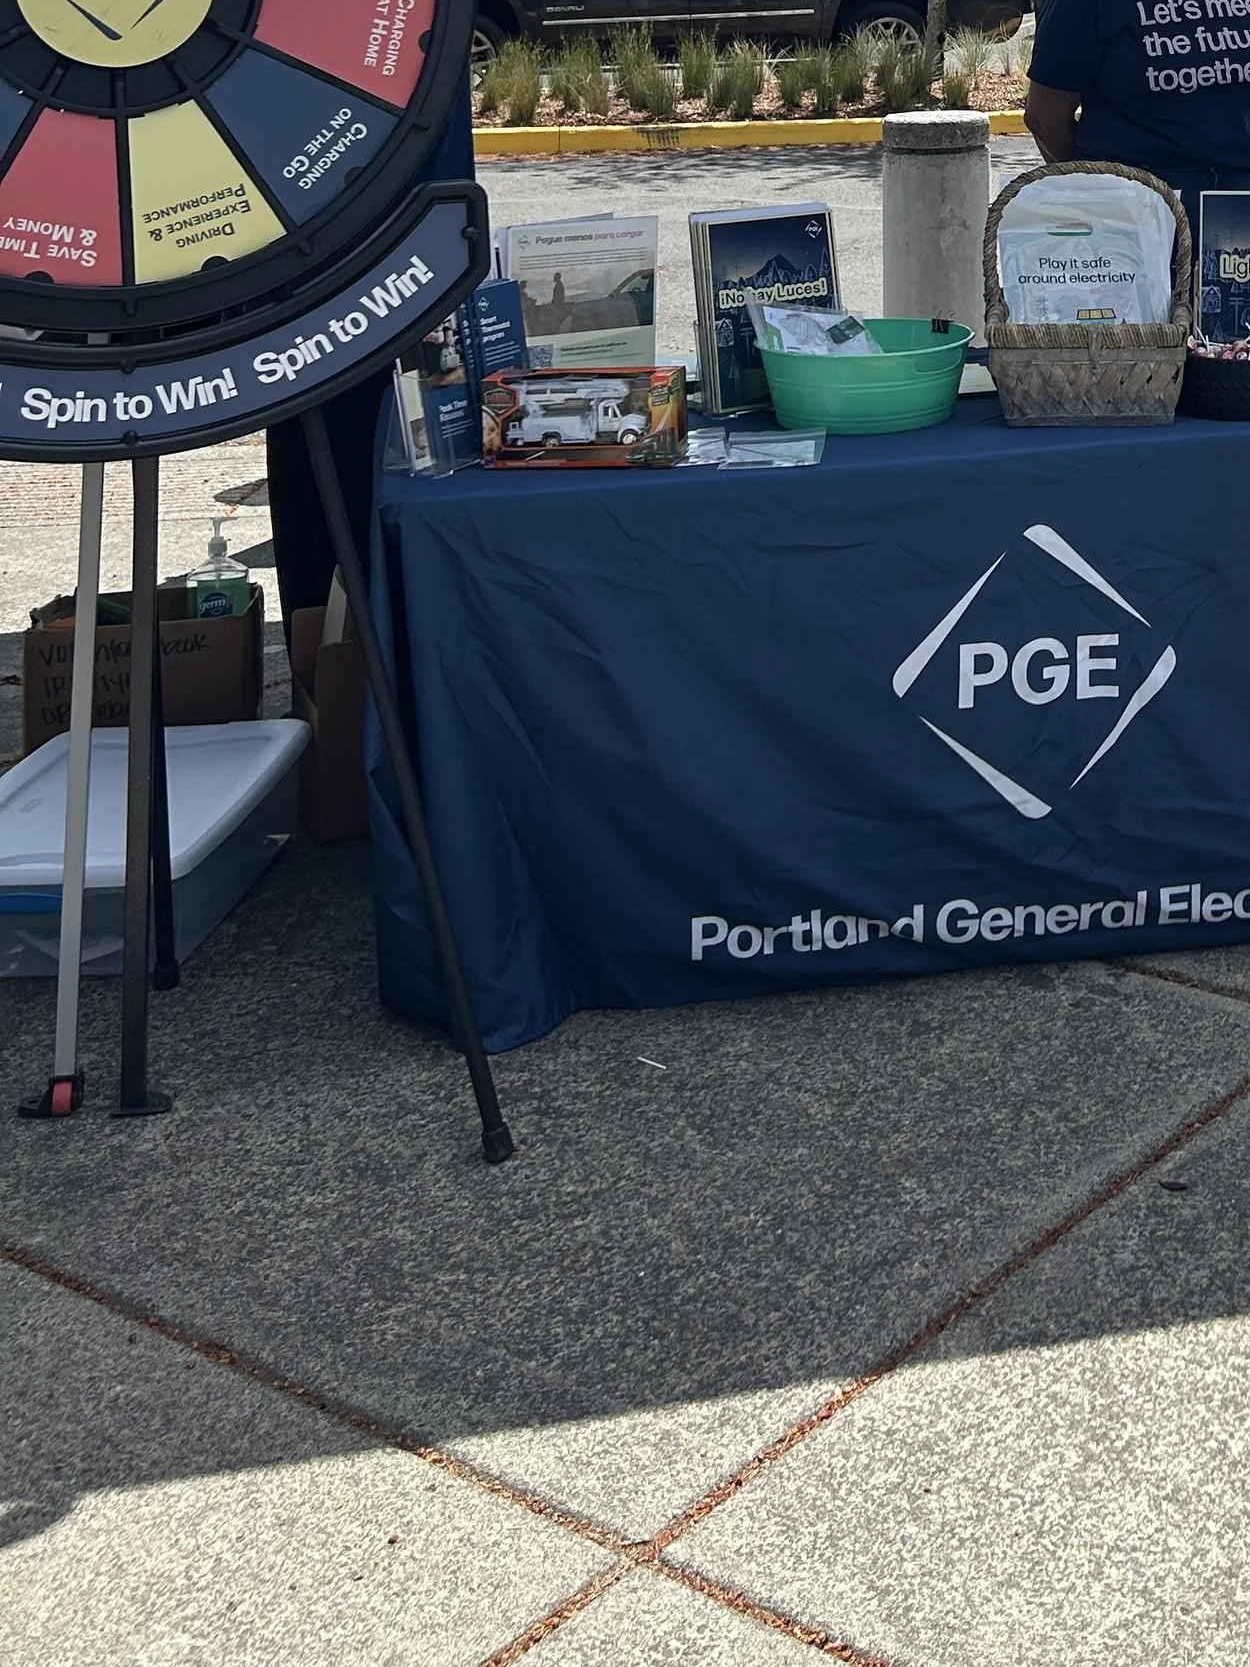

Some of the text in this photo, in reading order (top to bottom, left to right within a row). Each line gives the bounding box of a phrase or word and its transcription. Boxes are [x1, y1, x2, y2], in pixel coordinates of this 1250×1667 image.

[364, 18, 390, 68] HOME
[1142, 32, 1191, 56] the
[329, 107, 352, 130] ON
[297, 123, 368, 190] CHARGING
[304, 128, 334, 156] THE
[142, 183, 247, 224] PERFORMANCE
[2, 216, 98, 247] & MONEY
[148, 199, 252, 243] EXPERIENCE &
[175, 221, 236, 248] DRIVING
[564, 233, 593, 243] menos
[47, 243, 98, 267] SAVE
[1038, 257, 1111, 270] Play it safe
[752, 289, 773, 302] ay
[777, 280, 825, 298] Luces!
[1018, 272, 1136, 284] around electricity
[251, 254, 435, 385] Spin to Win!
[20, 367, 238, 429] Spin to Win!
[958, 633, 1120, 709] PGE
[691, 903, 924, 960] Portland
[936, 889, 1147, 944] General
